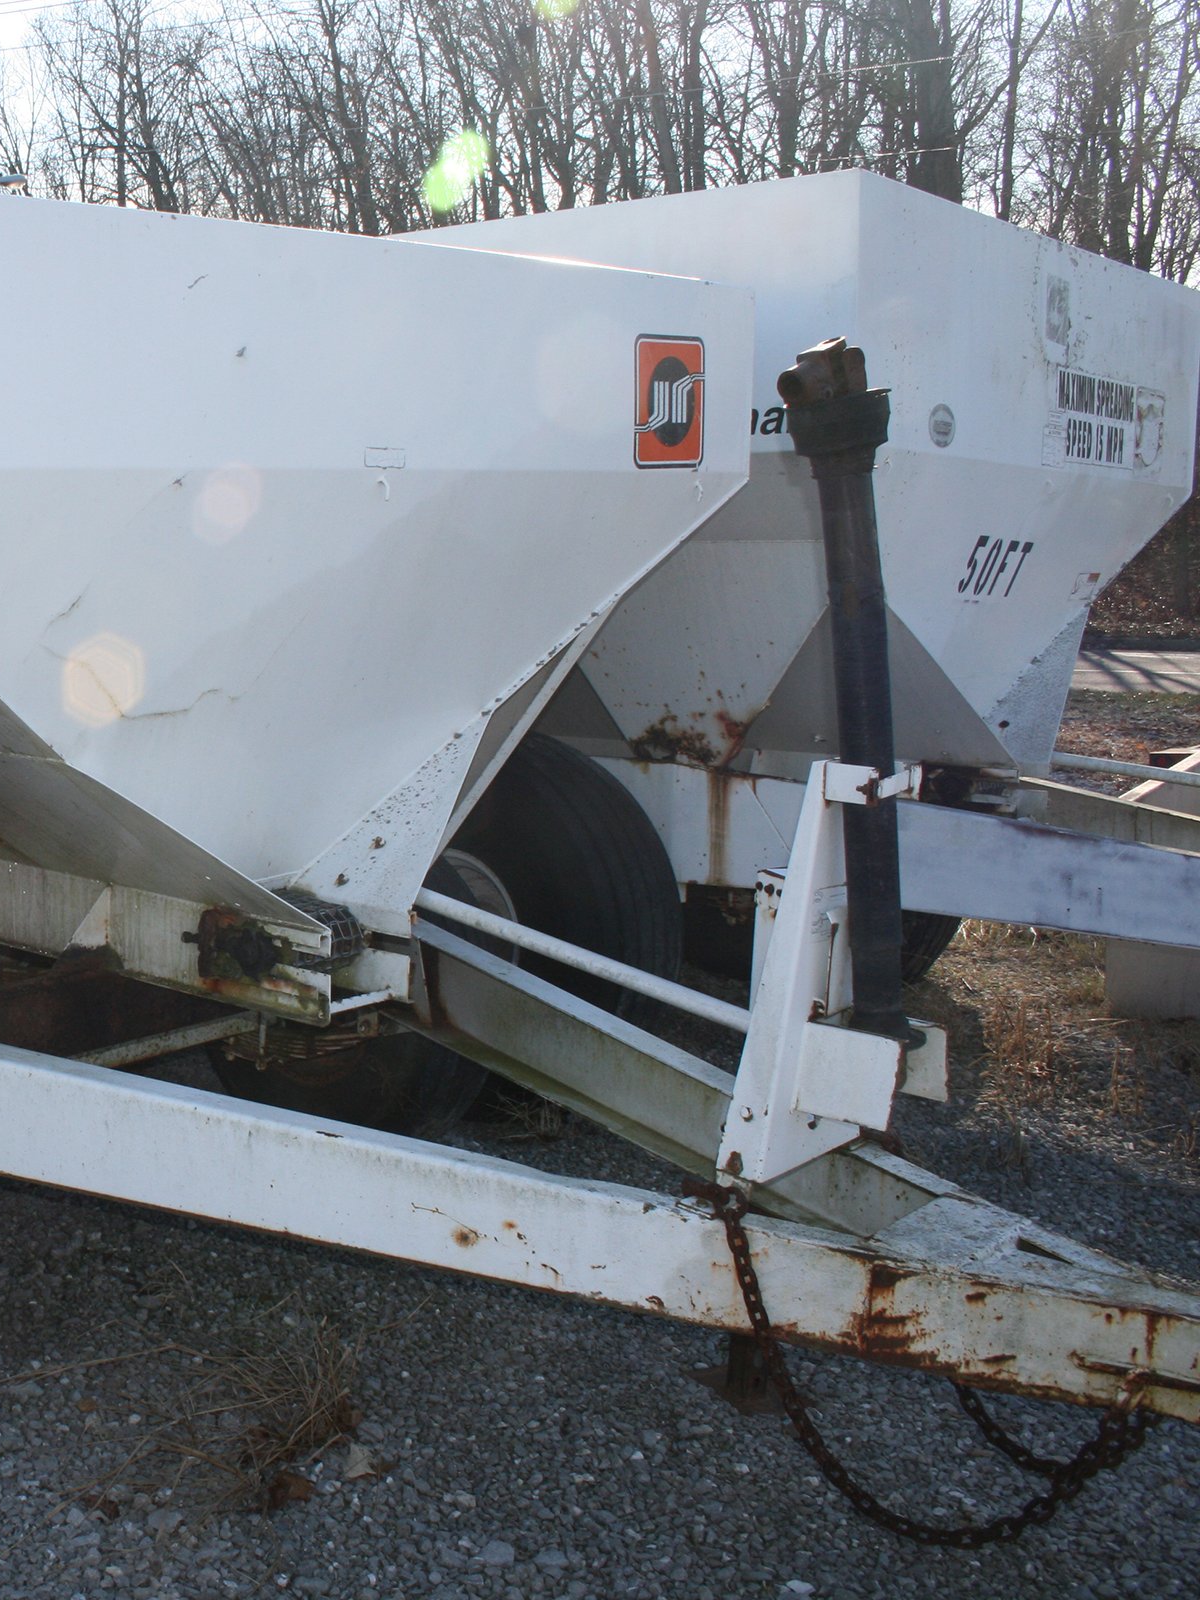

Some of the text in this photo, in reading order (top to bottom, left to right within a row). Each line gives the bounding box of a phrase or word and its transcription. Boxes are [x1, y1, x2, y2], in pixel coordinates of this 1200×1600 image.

[1058, 370, 1135, 423] MAXIMUM SPREADING
[1066, 418, 1092, 459] SPEED
[1106, 426, 1125, 464] MPH
[958, 535, 1034, 597] 50FT
